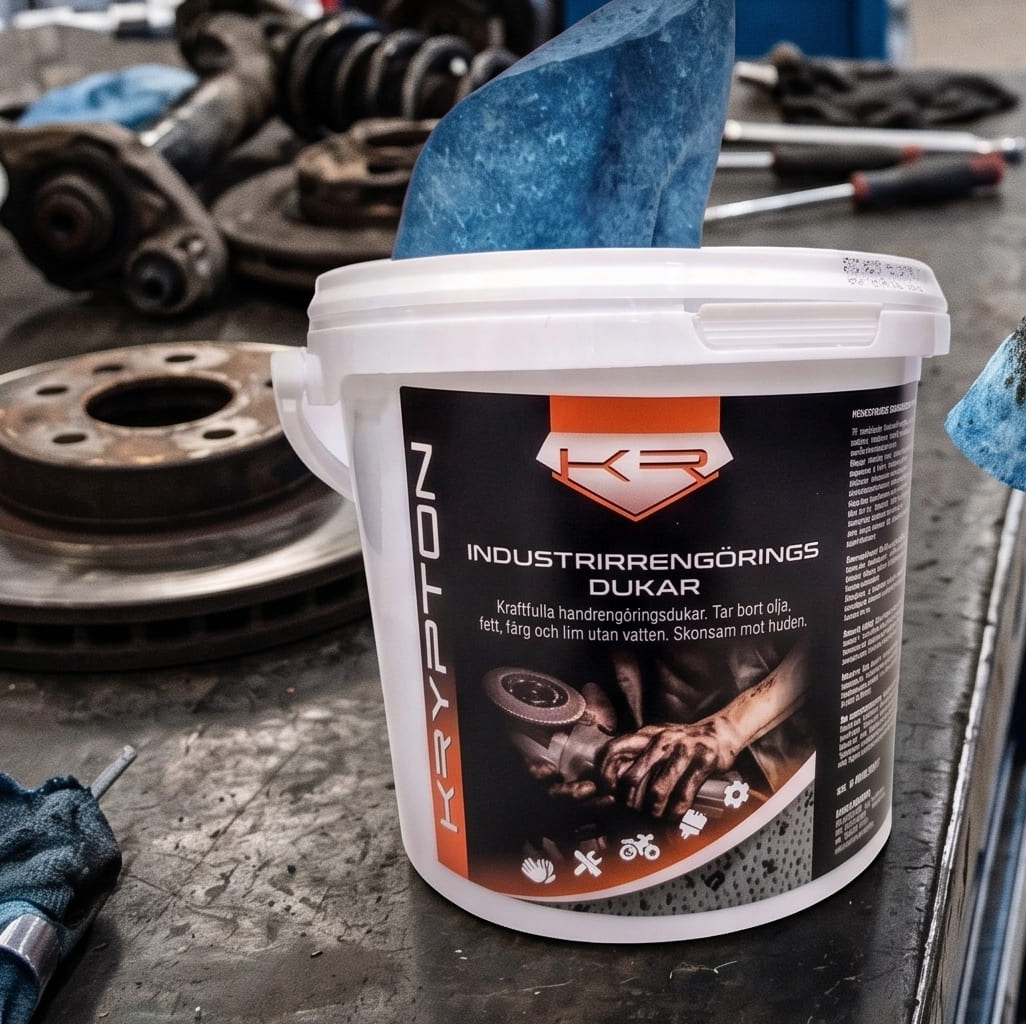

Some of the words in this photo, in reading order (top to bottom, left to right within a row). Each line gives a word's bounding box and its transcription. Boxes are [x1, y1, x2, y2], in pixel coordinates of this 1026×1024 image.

[467, 541, 819, 571] INDUSTRIRRENGÖRINGS
[589, 578, 701, 596] DUKAR
[496, 599, 555, 619] Kraftfulla
[712, 604, 734, 619] Tar
[737, 601, 763, 617] bort
[410, 441, 458, 833] KRYPTON
[479, 616, 503, 635] fett,
[534, 625, 559, 638] och
[563, 626, 584, 640] lim
[588, 627, 619, 641] utan
[622, 627, 669, 642] vatten.
[673, 625, 736, 641] Skonsam
[740, 620, 765, 636] mot
[768, 615, 808, 633] huden.
